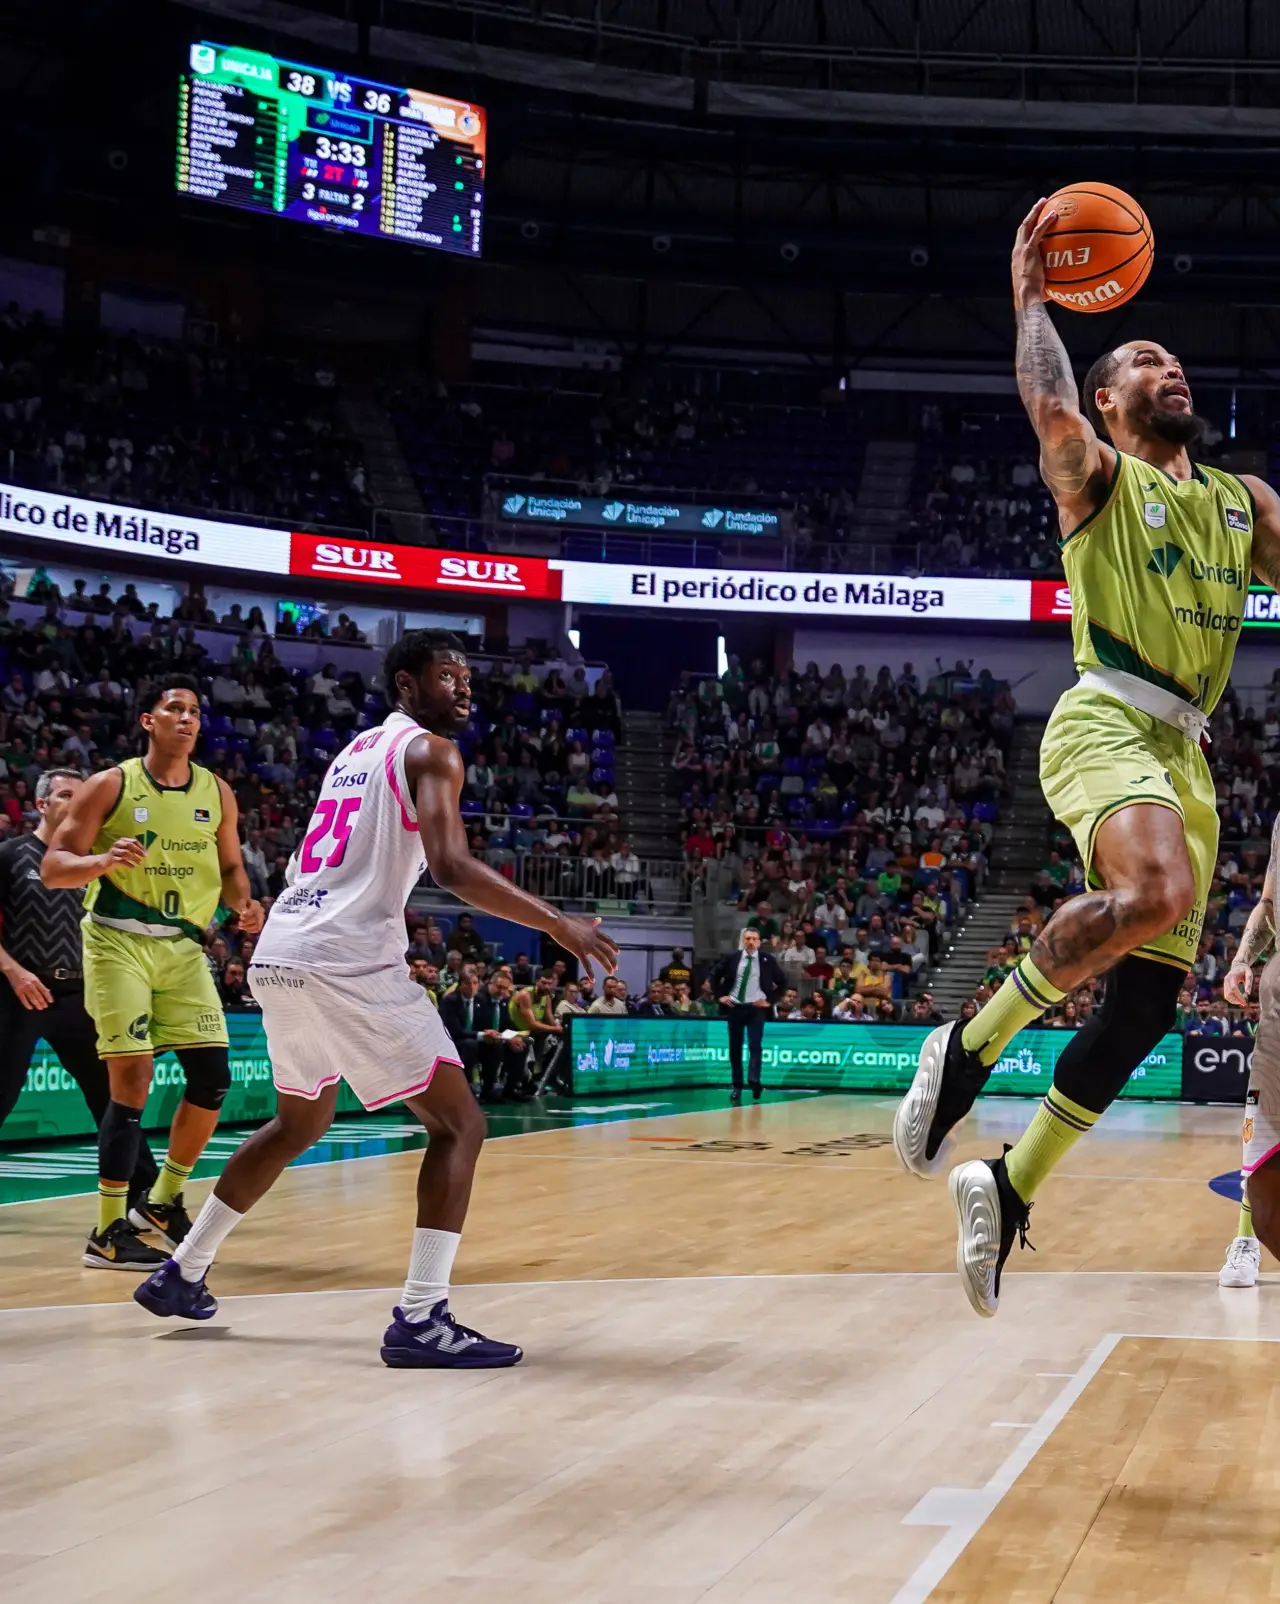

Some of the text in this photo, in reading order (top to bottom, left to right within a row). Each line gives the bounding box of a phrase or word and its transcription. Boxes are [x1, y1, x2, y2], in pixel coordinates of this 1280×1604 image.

[287, 72, 315, 95] 38
[327, 79, 352, 102] VS
[363, 90, 391, 114] 36
[316, 136, 366, 167] 3:33
[302, 182, 315, 200] 3
[351, 193, 365, 211] 2
[527, 505, 568, 521] Unicaja
[626, 511, 666, 529] Unicaja
[725, 519, 764, 535] Unicaja
[52, 504, 88, 533] de
[95, 511, 200, 555] Málaga
[315, 543, 397, 571] SUR
[440, 558, 522, 583] SUR
[1190, 557, 1245, 591] Unicaj
[631, 572, 944, 613] El periódico de Málaga
[161, 839, 208, 853] Unicaja
[301, 797, 362, 873] 25
[165, 890, 179, 917] 0
